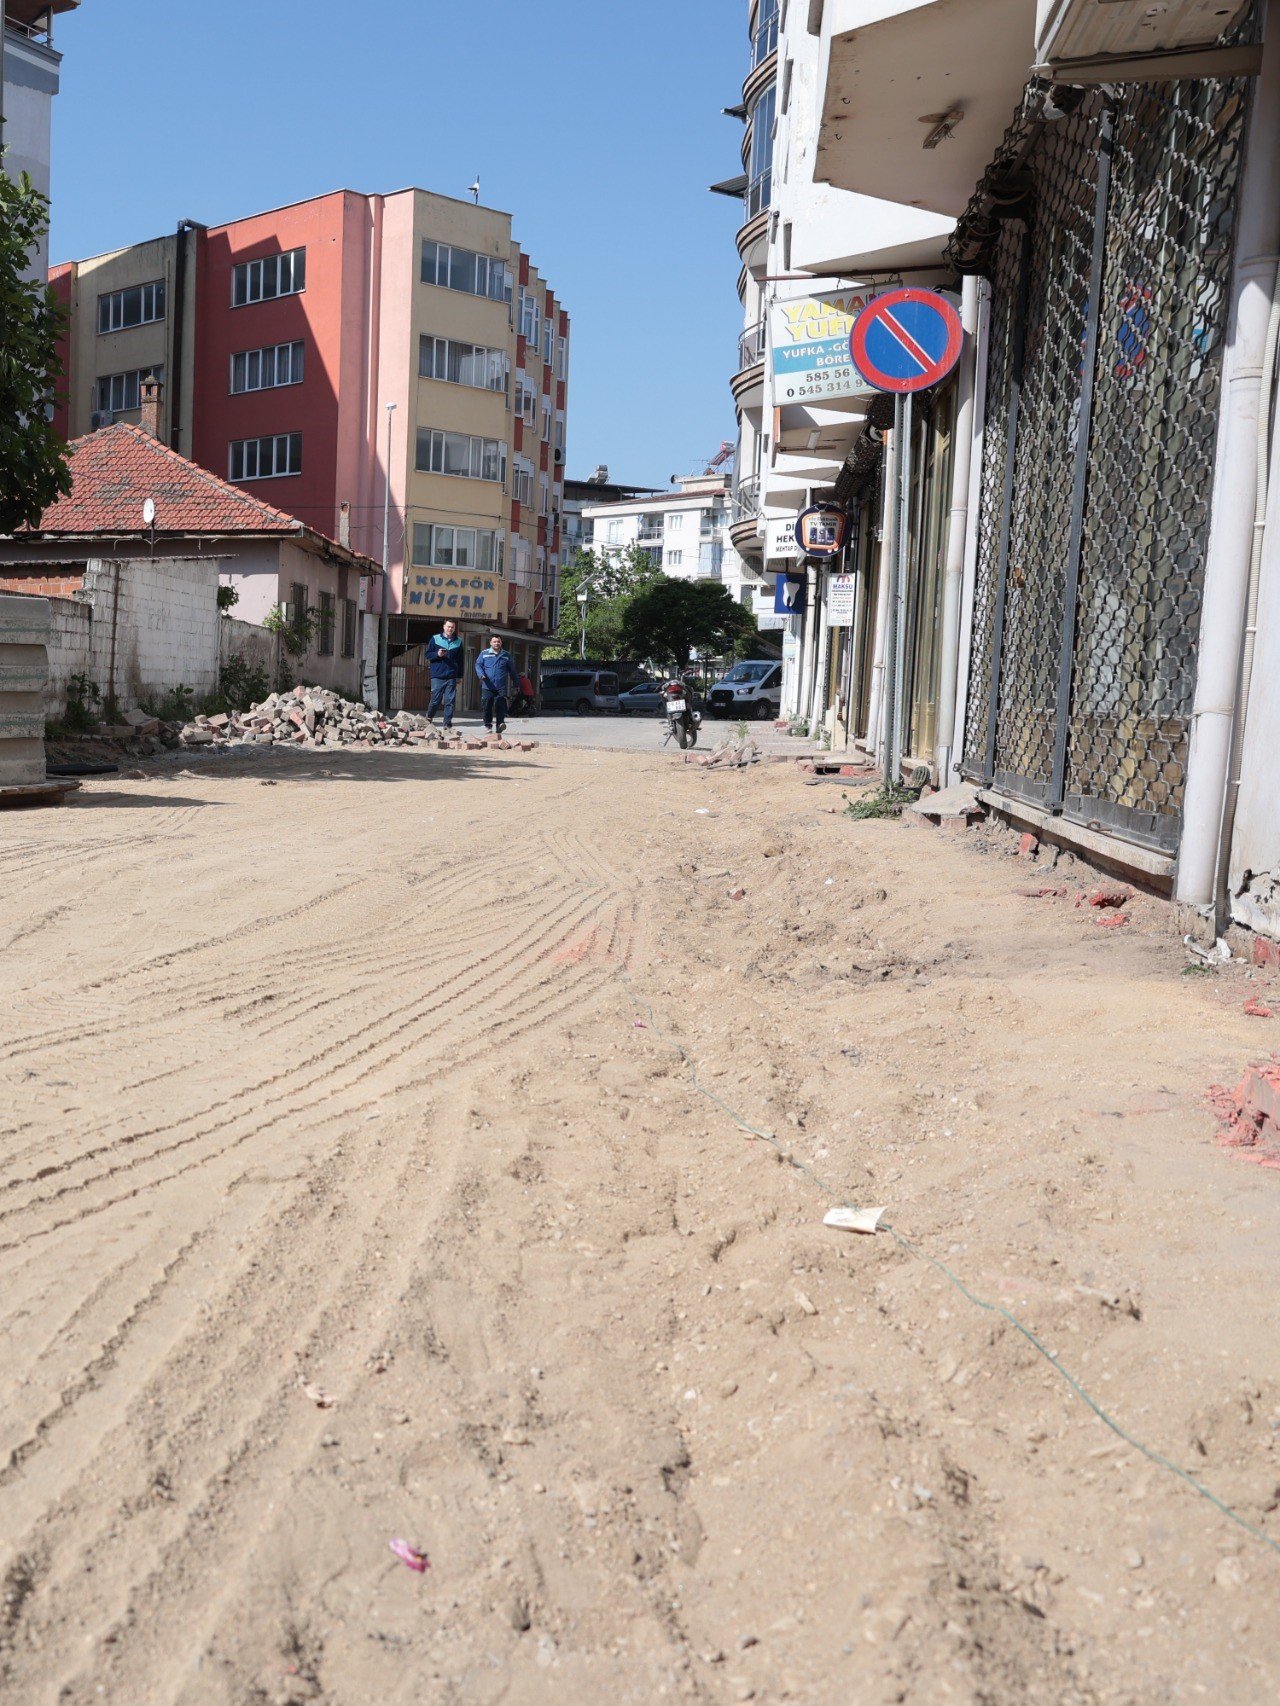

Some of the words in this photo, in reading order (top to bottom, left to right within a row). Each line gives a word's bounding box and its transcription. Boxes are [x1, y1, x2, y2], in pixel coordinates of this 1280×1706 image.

[783, 345, 825, 359] YUFKA
[816, 353, 851, 367] BÖRE
[806, 371, 830, 383] 585
[834, 368, 851, 379] 56
[786, 388, 795, 398] 0
[798, 384, 823, 396] 545
[827, 380, 851, 392] 314
[776, 534, 795, 543] HEK
[415, 575, 495, 590] KUAFÖR
[409, 589, 485, 610] MÜJGAN
